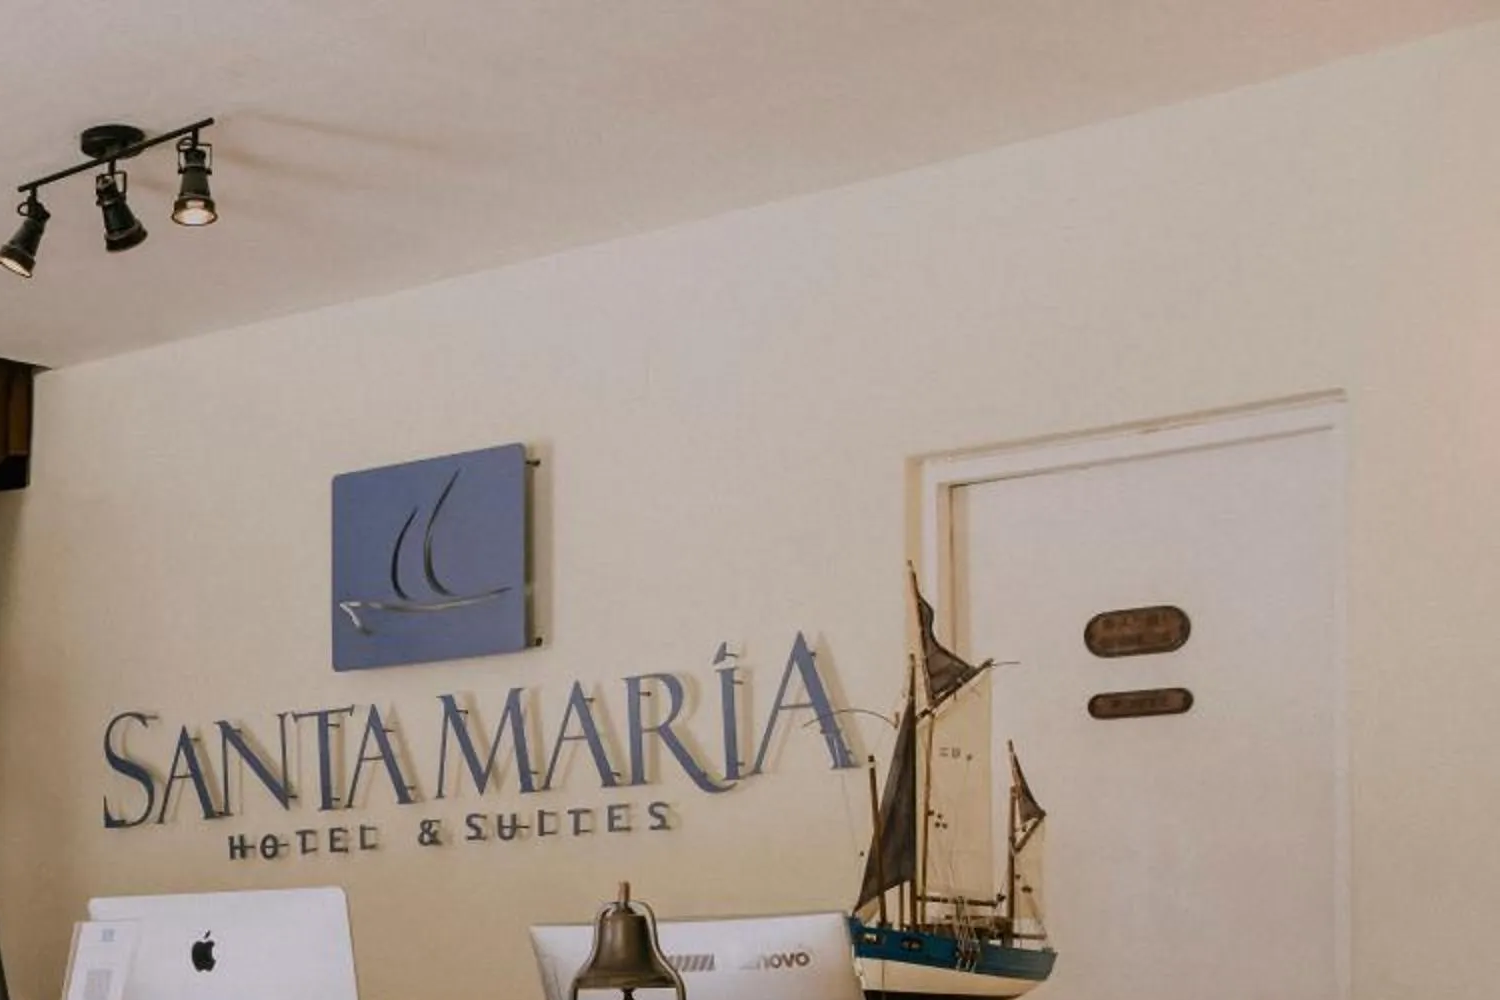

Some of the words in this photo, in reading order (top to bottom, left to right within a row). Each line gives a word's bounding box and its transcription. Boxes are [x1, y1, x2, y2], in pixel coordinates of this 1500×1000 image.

[102, 703, 417, 829] SANTA
[436, 630, 859, 798] MARÍA
[228, 825, 380, 860] HOTEL
[418, 819, 442, 846] &
[465, 802, 671, 841] SUITES
